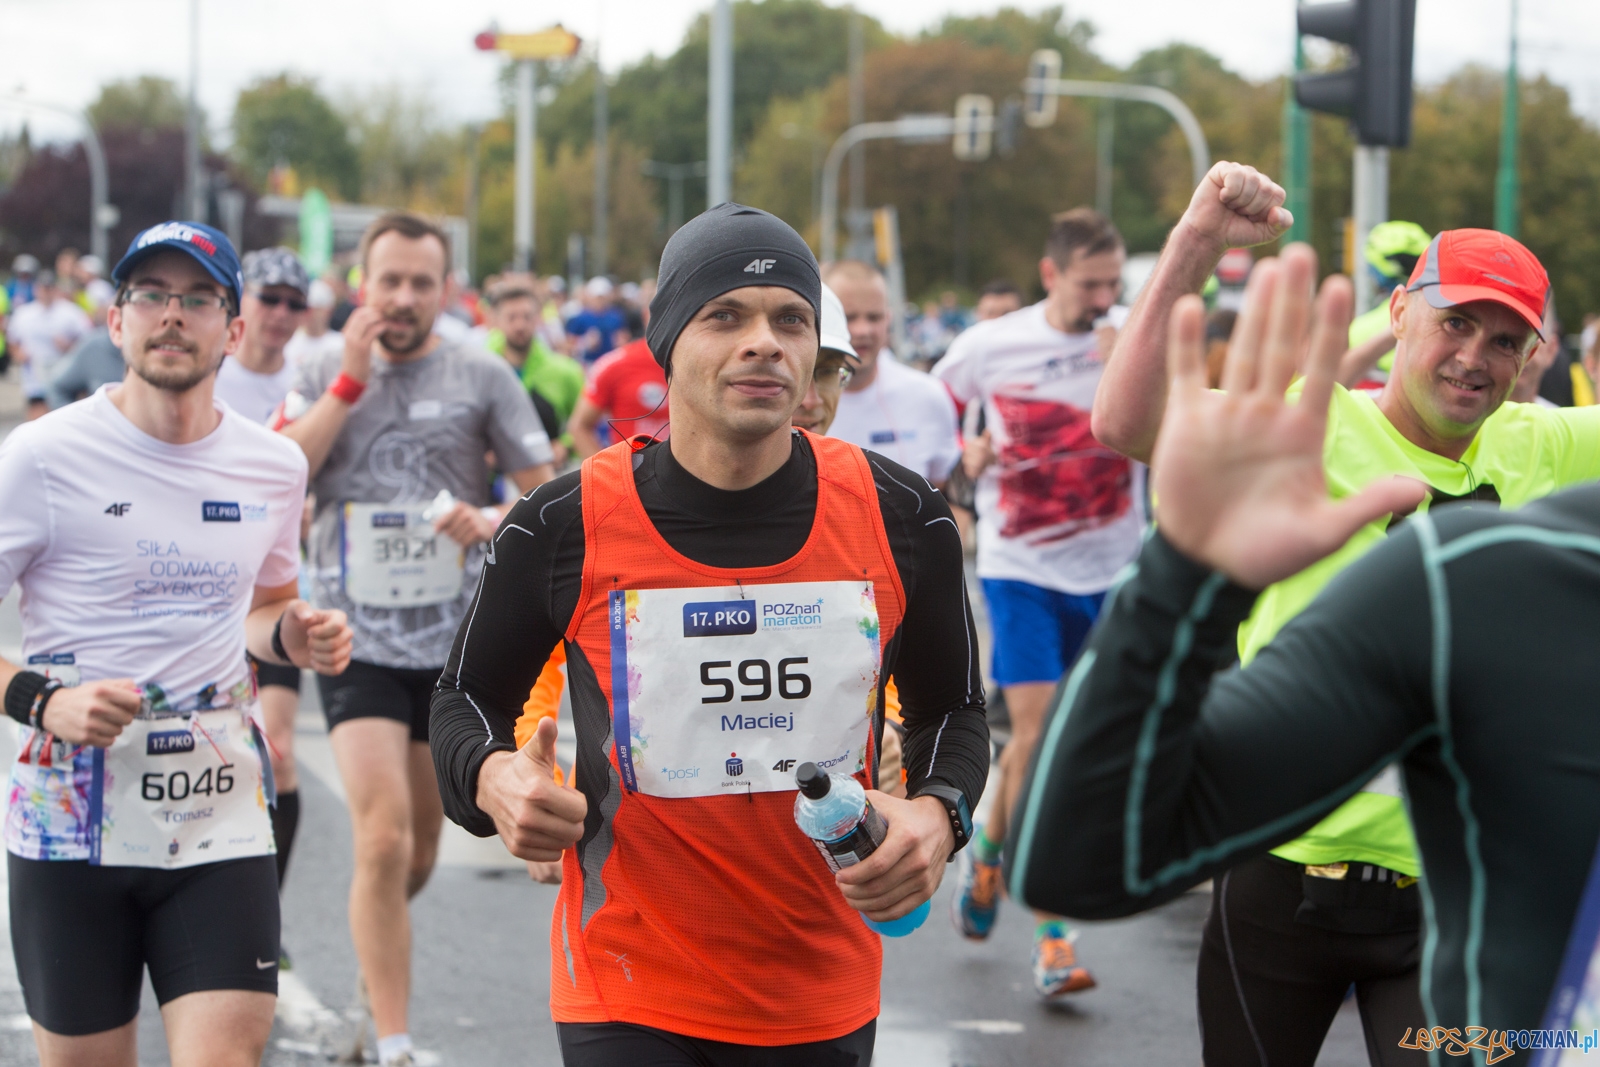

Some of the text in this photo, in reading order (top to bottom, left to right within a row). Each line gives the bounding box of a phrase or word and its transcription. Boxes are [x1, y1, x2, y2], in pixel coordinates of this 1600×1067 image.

[743, 258, 777, 274] 4F
[104, 502, 132, 517] 4F
[136, 540, 181, 557] SIŁA
[374, 537, 437, 563] 3921
[150, 560, 239, 578] ODWAGA
[133, 580, 237, 599] SZYBKOŚĆ
[715, 610, 751, 626] PKO
[763, 613, 821, 627] maraton
[700, 657, 812, 704] 596
[721, 712, 794, 732] Maciej
[772, 760, 796, 772] 4F
[141, 764, 234, 801] 6046
[163, 806, 214, 824] Tomasz
